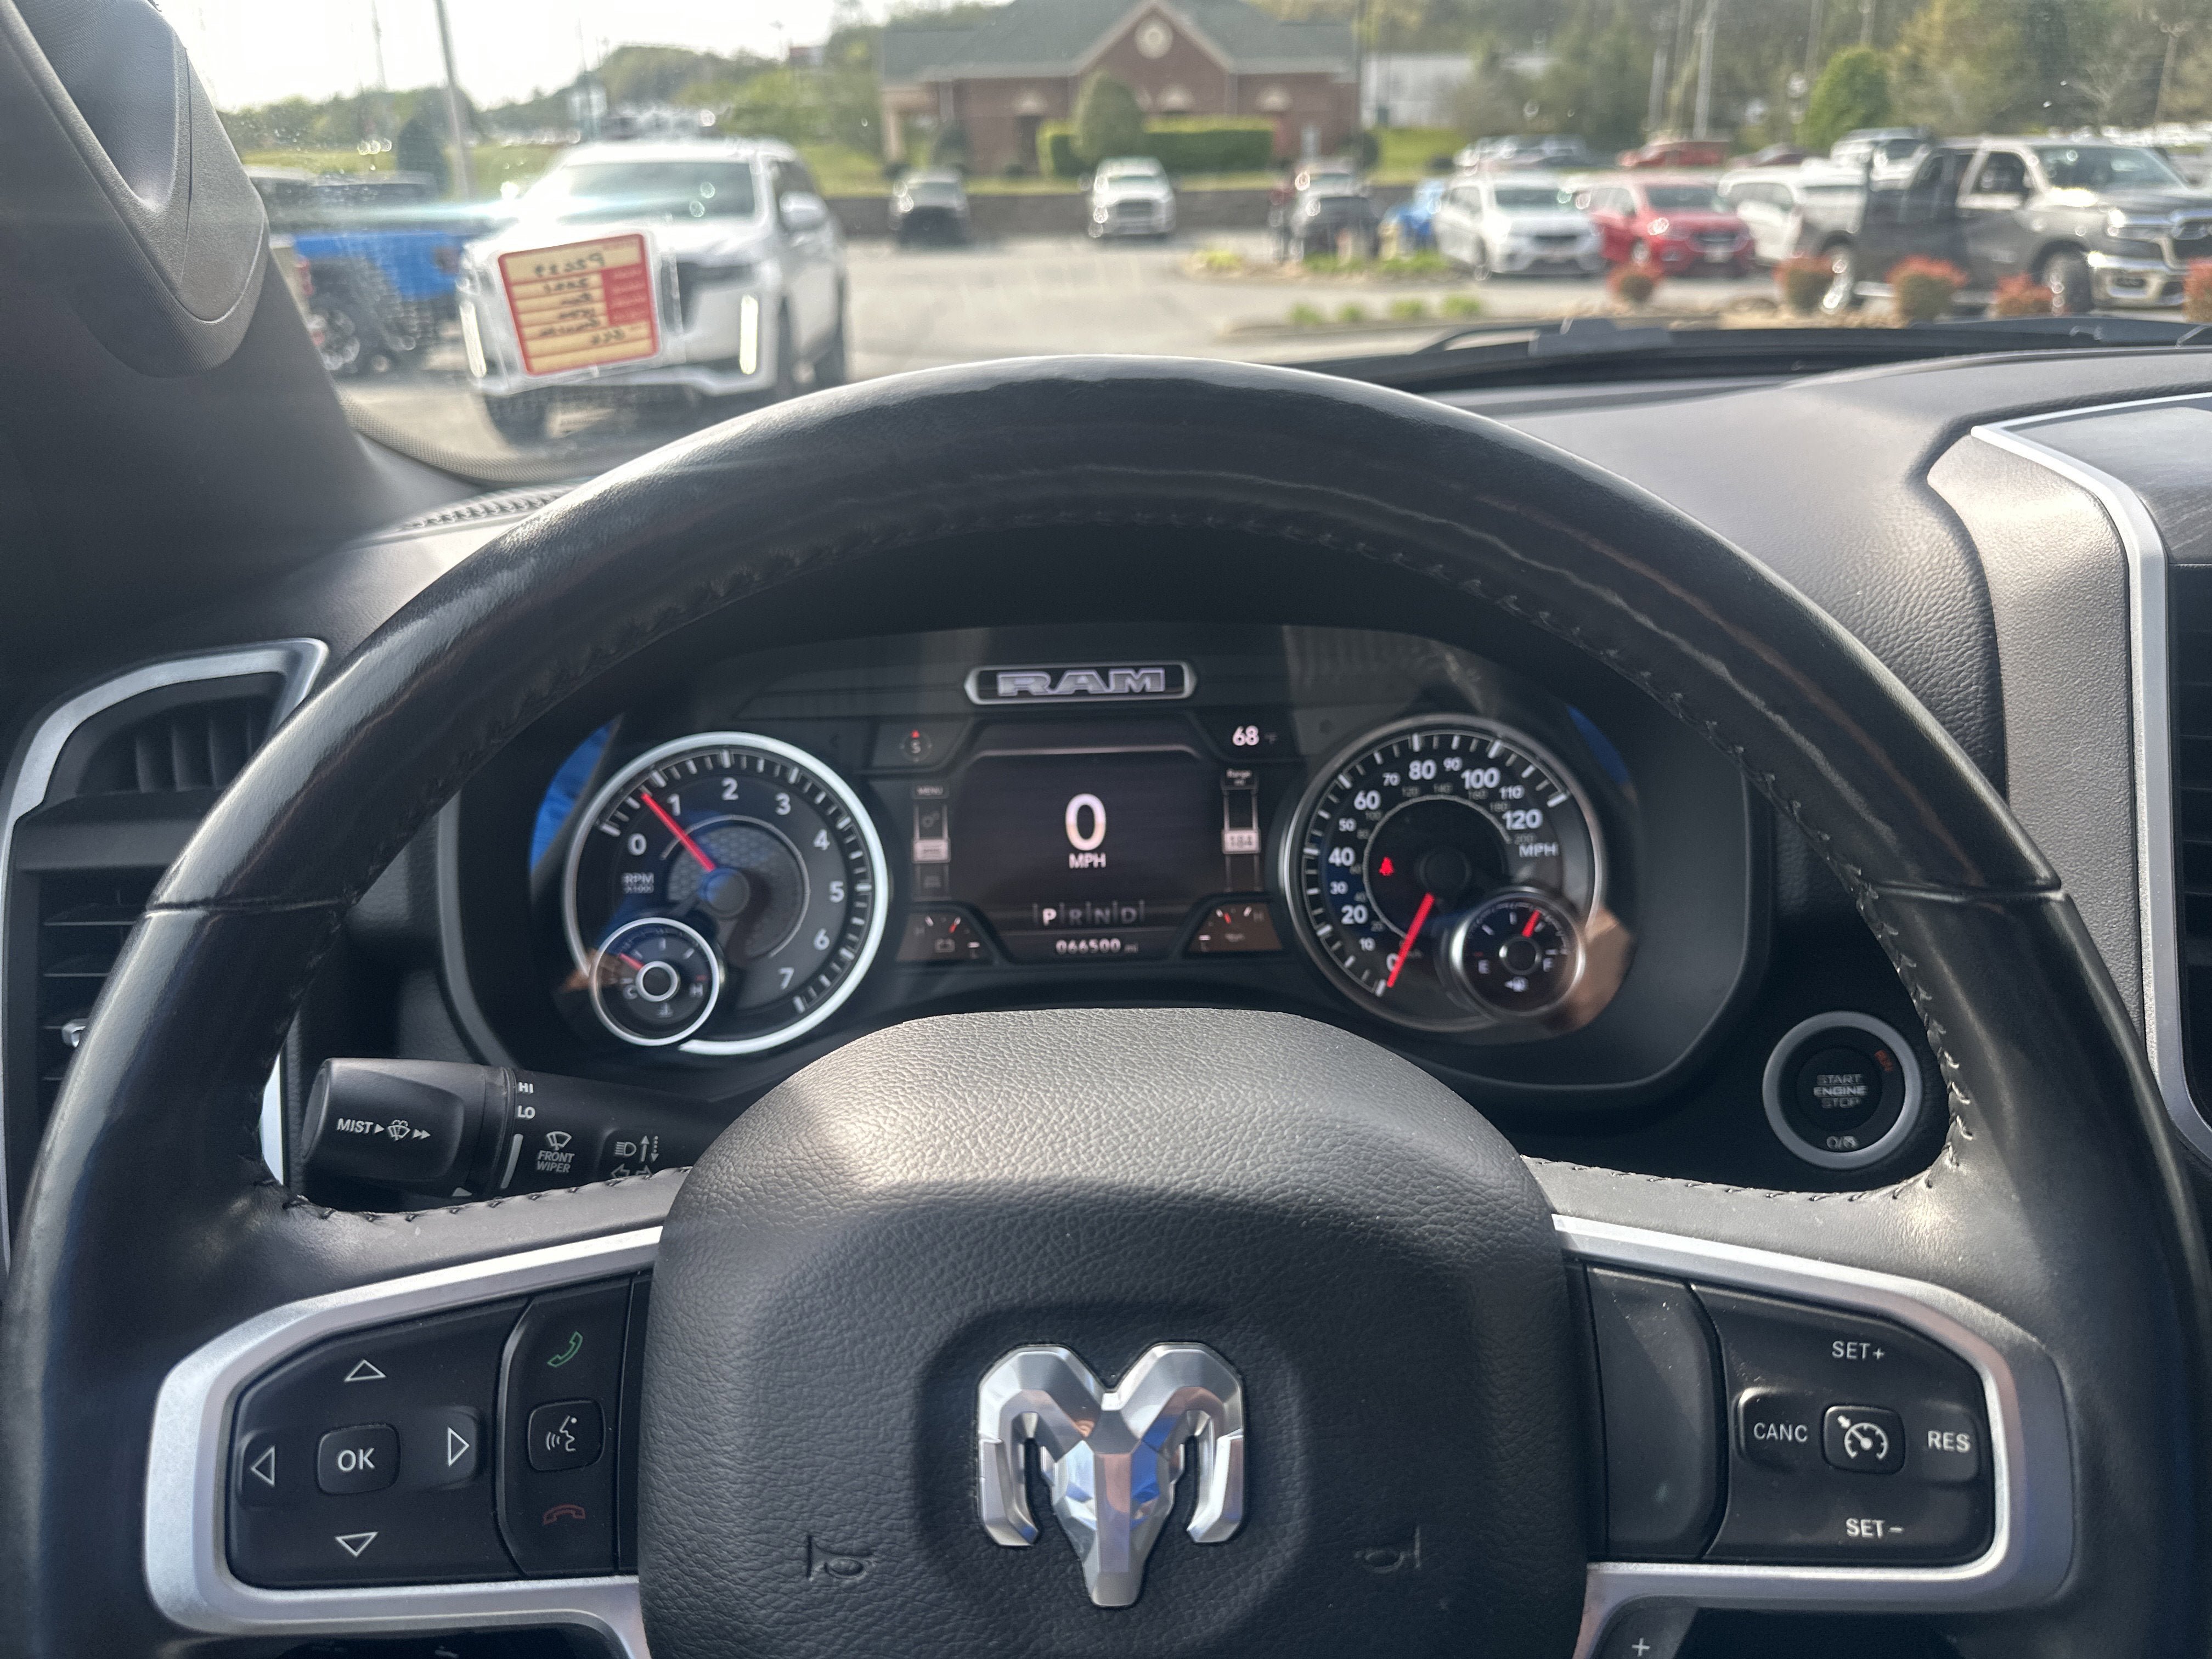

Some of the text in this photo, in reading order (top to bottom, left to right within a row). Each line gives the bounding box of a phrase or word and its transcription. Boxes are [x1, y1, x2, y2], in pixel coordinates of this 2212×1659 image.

[997, 668, 1165, 697] RAM
[1232, 725, 1260, 746] 68
[911, 740, 921, 754] S
[1408, 759, 1437, 780] 80
[1443, 757, 1463, 771] 90
[1382, 772, 1400, 786] 70
[1460, 767, 1500, 789] 100
[723, 777, 738, 800] 2
[916, 785, 944, 795] MENU
[1499, 785, 1525, 799] 110
[667, 793, 681, 816] 1
[775, 792, 791, 815] 3
[1353, 789, 1381, 810] 60
[1065, 793, 1107, 851] 0
[1339, 817, 1356, 832] 50
[1502, 808, 1543, 830] 120
[628, 833, 647, 855] 0
[813, 828, 830, 850] 4
[1328, 846, 1355, 867] 40
[1519, 842, 1559, 857] MPH
[1069, 853, 1106, 869] MPH
[622, 872, 654, 884] RPM
[830, 881, 844, 904] 5
[1329, 881, 1348, 895] 30
[1042, 906, 1137, 926] P R N D
[1341, 904, 1368, 924] 20
[813, 928, 830, 951] 6
[1056, 938, 1121, 955] 066500
[1359, 937, 1376, 951] 10
[1478, 959, 1490, 974] E
[1542, 957, 1554, 972] F
[779, 967, 795, 989] 7
[623, 985, 638, 1000] C
[689, 983, 704, 998] H
[517, 1081, 535, 1095] HI
[1816, 1074, 1862, 1086] START
[1813, 1085, 1868, 1097] ENGINE
[1821, 1097, 1861, 1109] STOP
[517, 1105, 537, 1120] LO
[336, 1118, 374, 1135] MIST
[538, 1149, 575, 1164] FRONT
[536, 1160, 571, 1174] WIPER
[1753, 1422, 1808, 1443] CANC
[1927, 1430, 1971, 1453] RES
[337, 1447, 375, 1472] OK
